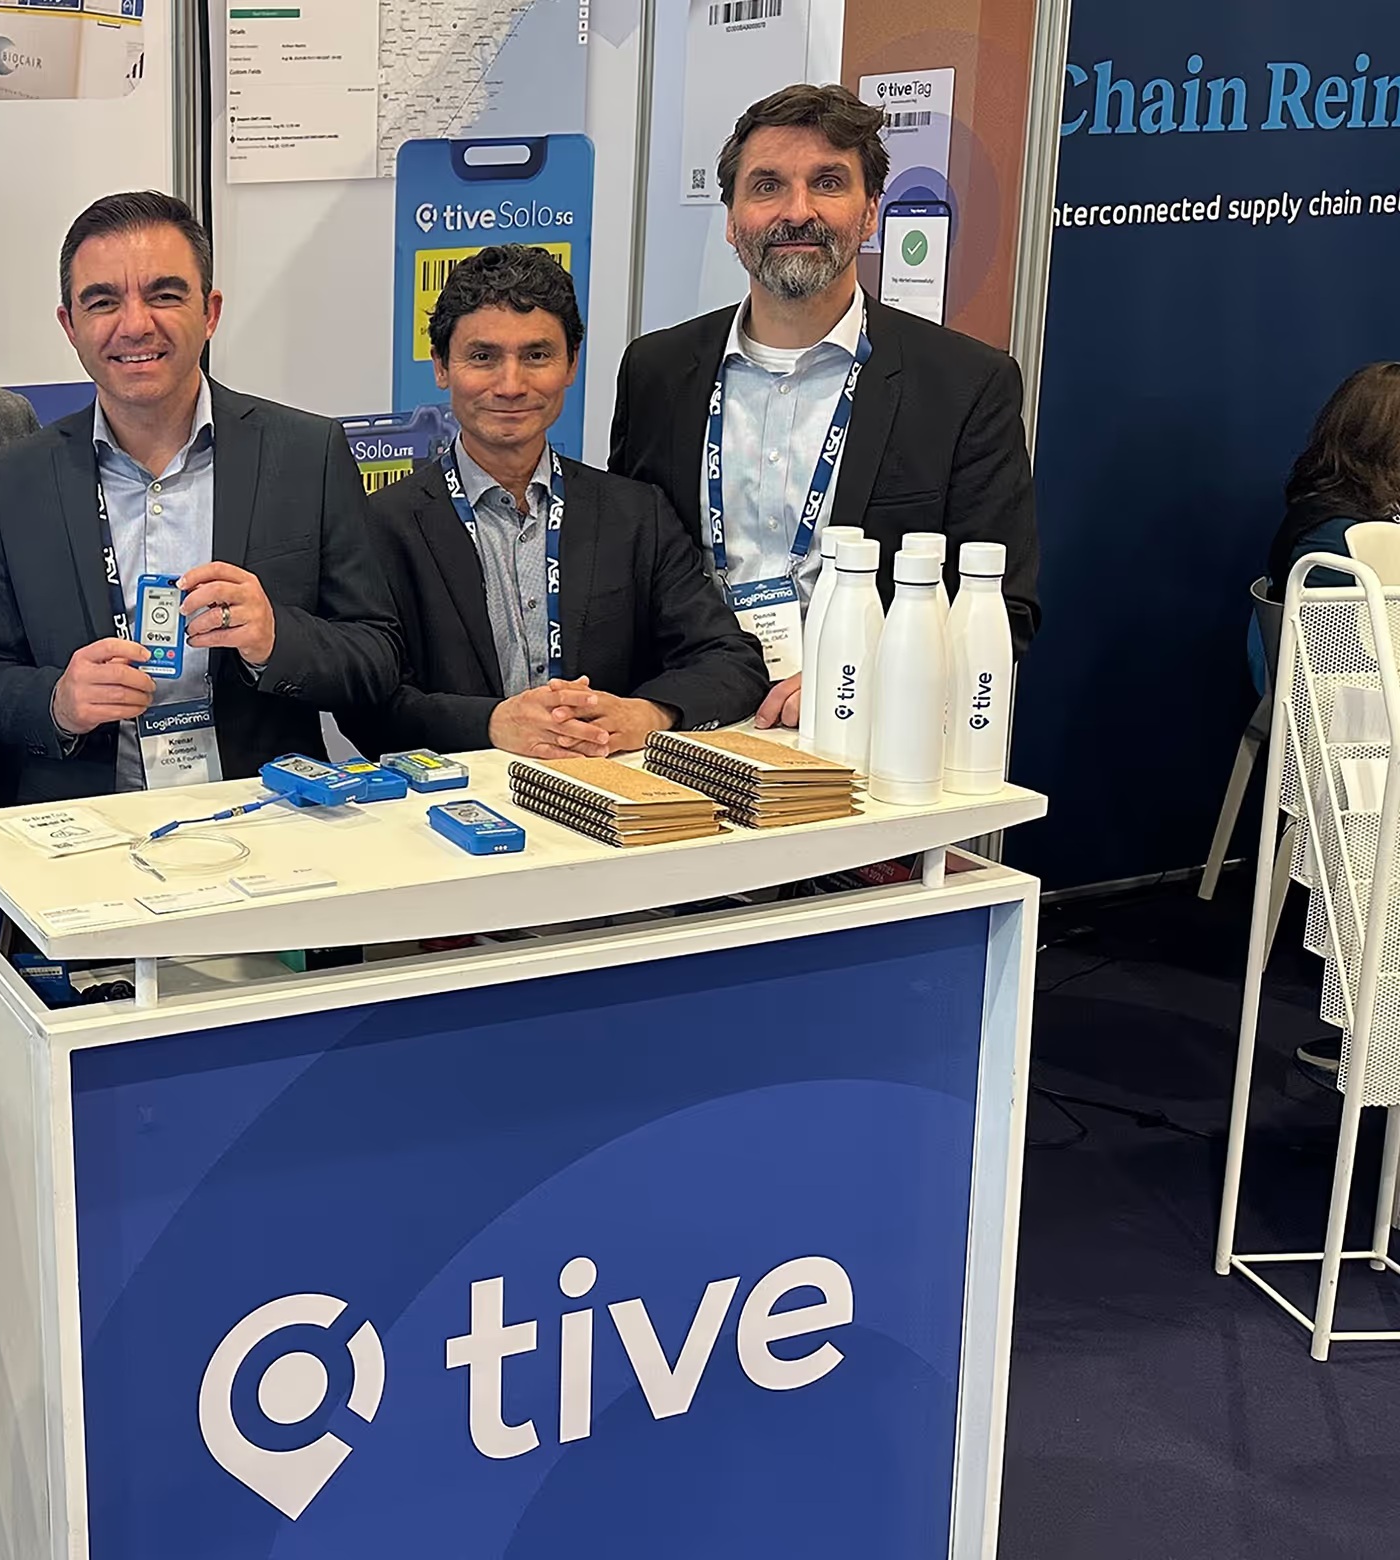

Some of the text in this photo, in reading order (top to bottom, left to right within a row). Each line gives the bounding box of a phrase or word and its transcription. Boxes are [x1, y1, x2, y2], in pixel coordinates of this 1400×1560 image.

[2, 51, 42, 69] BIOCAIR
[1059, 54, 1248, 137] Chain
[1228, 192, 1302, 225] supply
[1308, 189, 1361, 217] chain
[844, 362, 862, 401] DSV
[394, 447, 414, 457] LITE
[708, 442, 720, 479] DSV
[822, 426, 844, 466] DSV
[444, 468, 466, 499] DSV
[548, 494, 565, 530] DSV
[710, 507, 723, 543] DSV
[802, 491, 823, 530] DSV
[547, 557, 560, 594] DSV
[734, 588, 793, 606] LogiPharma
[155, 612, 166, 620] OK
[154, 633, 171, 642] tive
[550, 620, 562, 658] DSV
[837, 664, 856, 701] tive
[973, 672, 992, 709] tive
[145, 714, 210, 731] LogiPharma
[446, 1255, 854, 1460] tive
